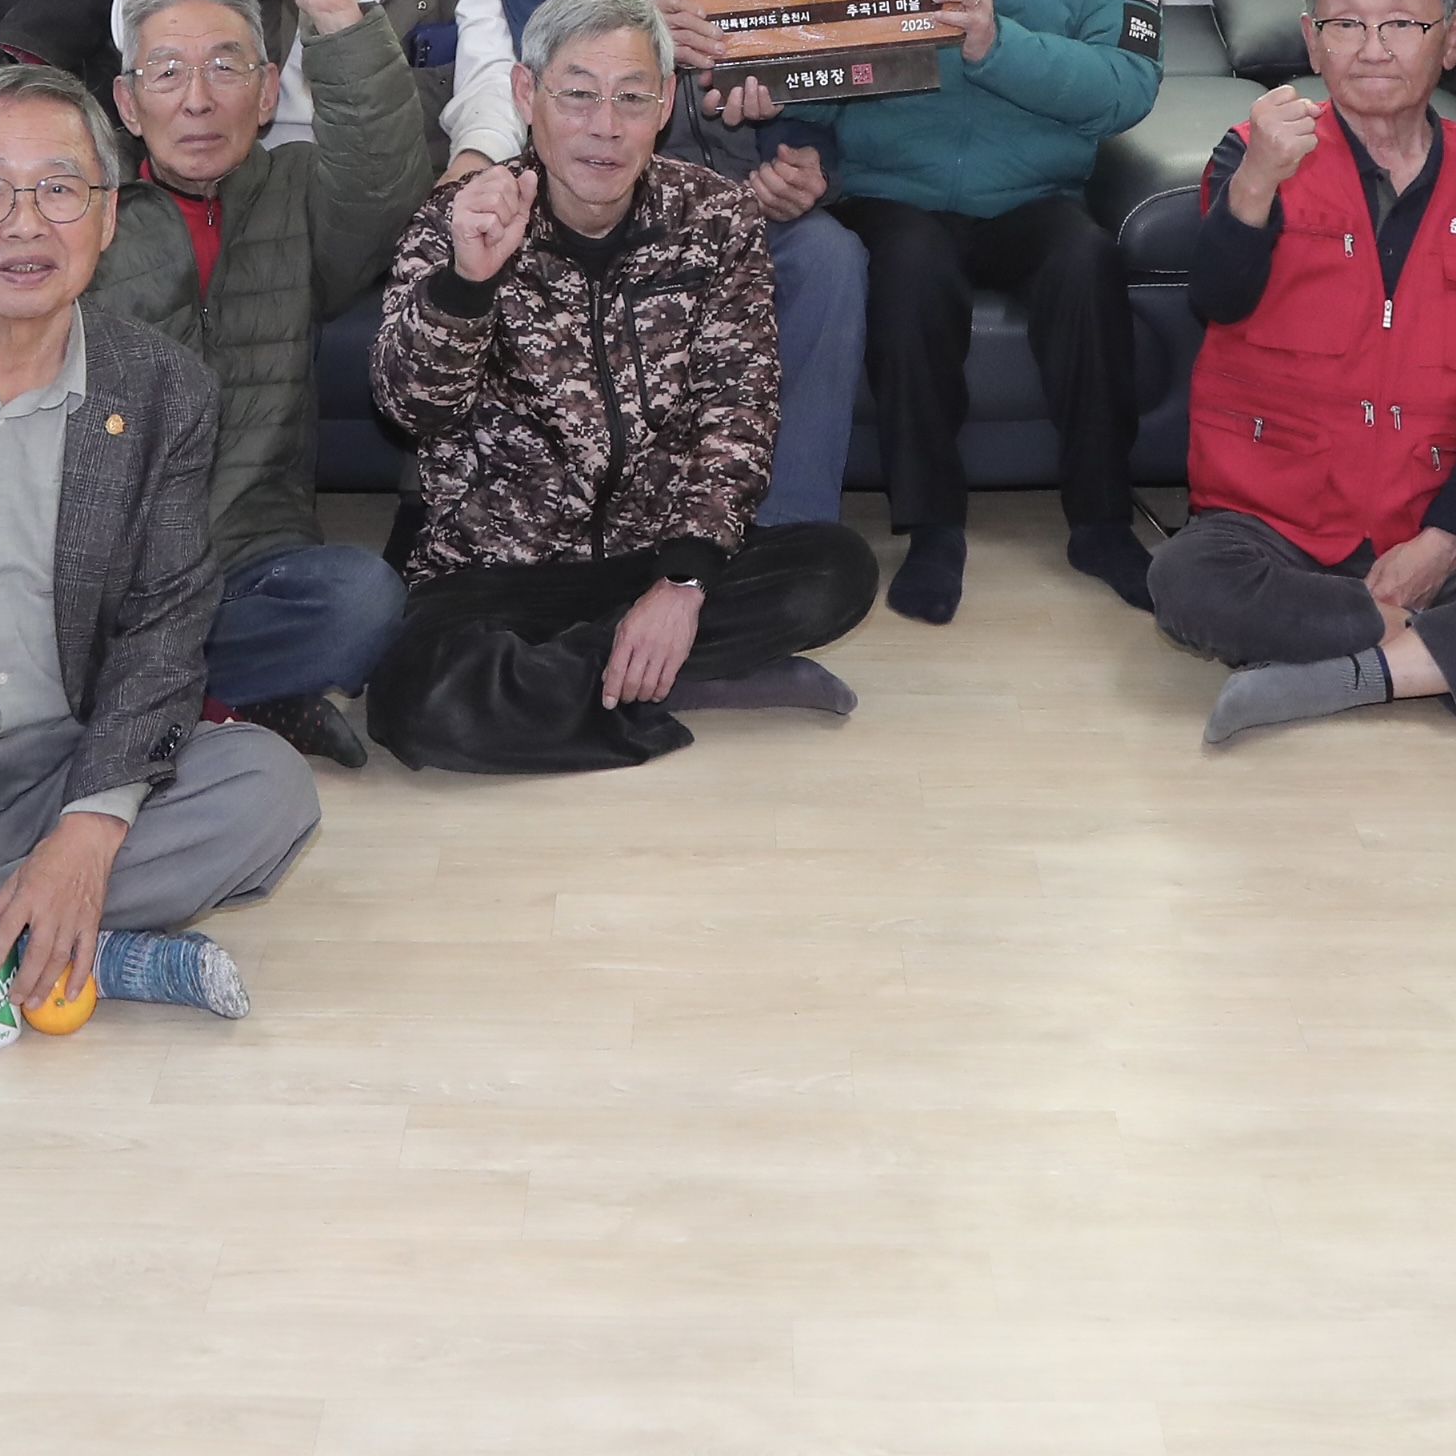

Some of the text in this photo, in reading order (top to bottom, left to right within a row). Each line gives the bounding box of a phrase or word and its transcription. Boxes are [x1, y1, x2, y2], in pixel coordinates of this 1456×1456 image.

[846, 0, 890, 16] 추곡1리
[780, 11, 810, 25] 춘천시
[1130, 17, 1147, 27] FILA
[1129, 30, 1148, 42] INT.
[1130, 24, 1157, 39] SPORT
[786, 67, 845, 88] 산림청장
